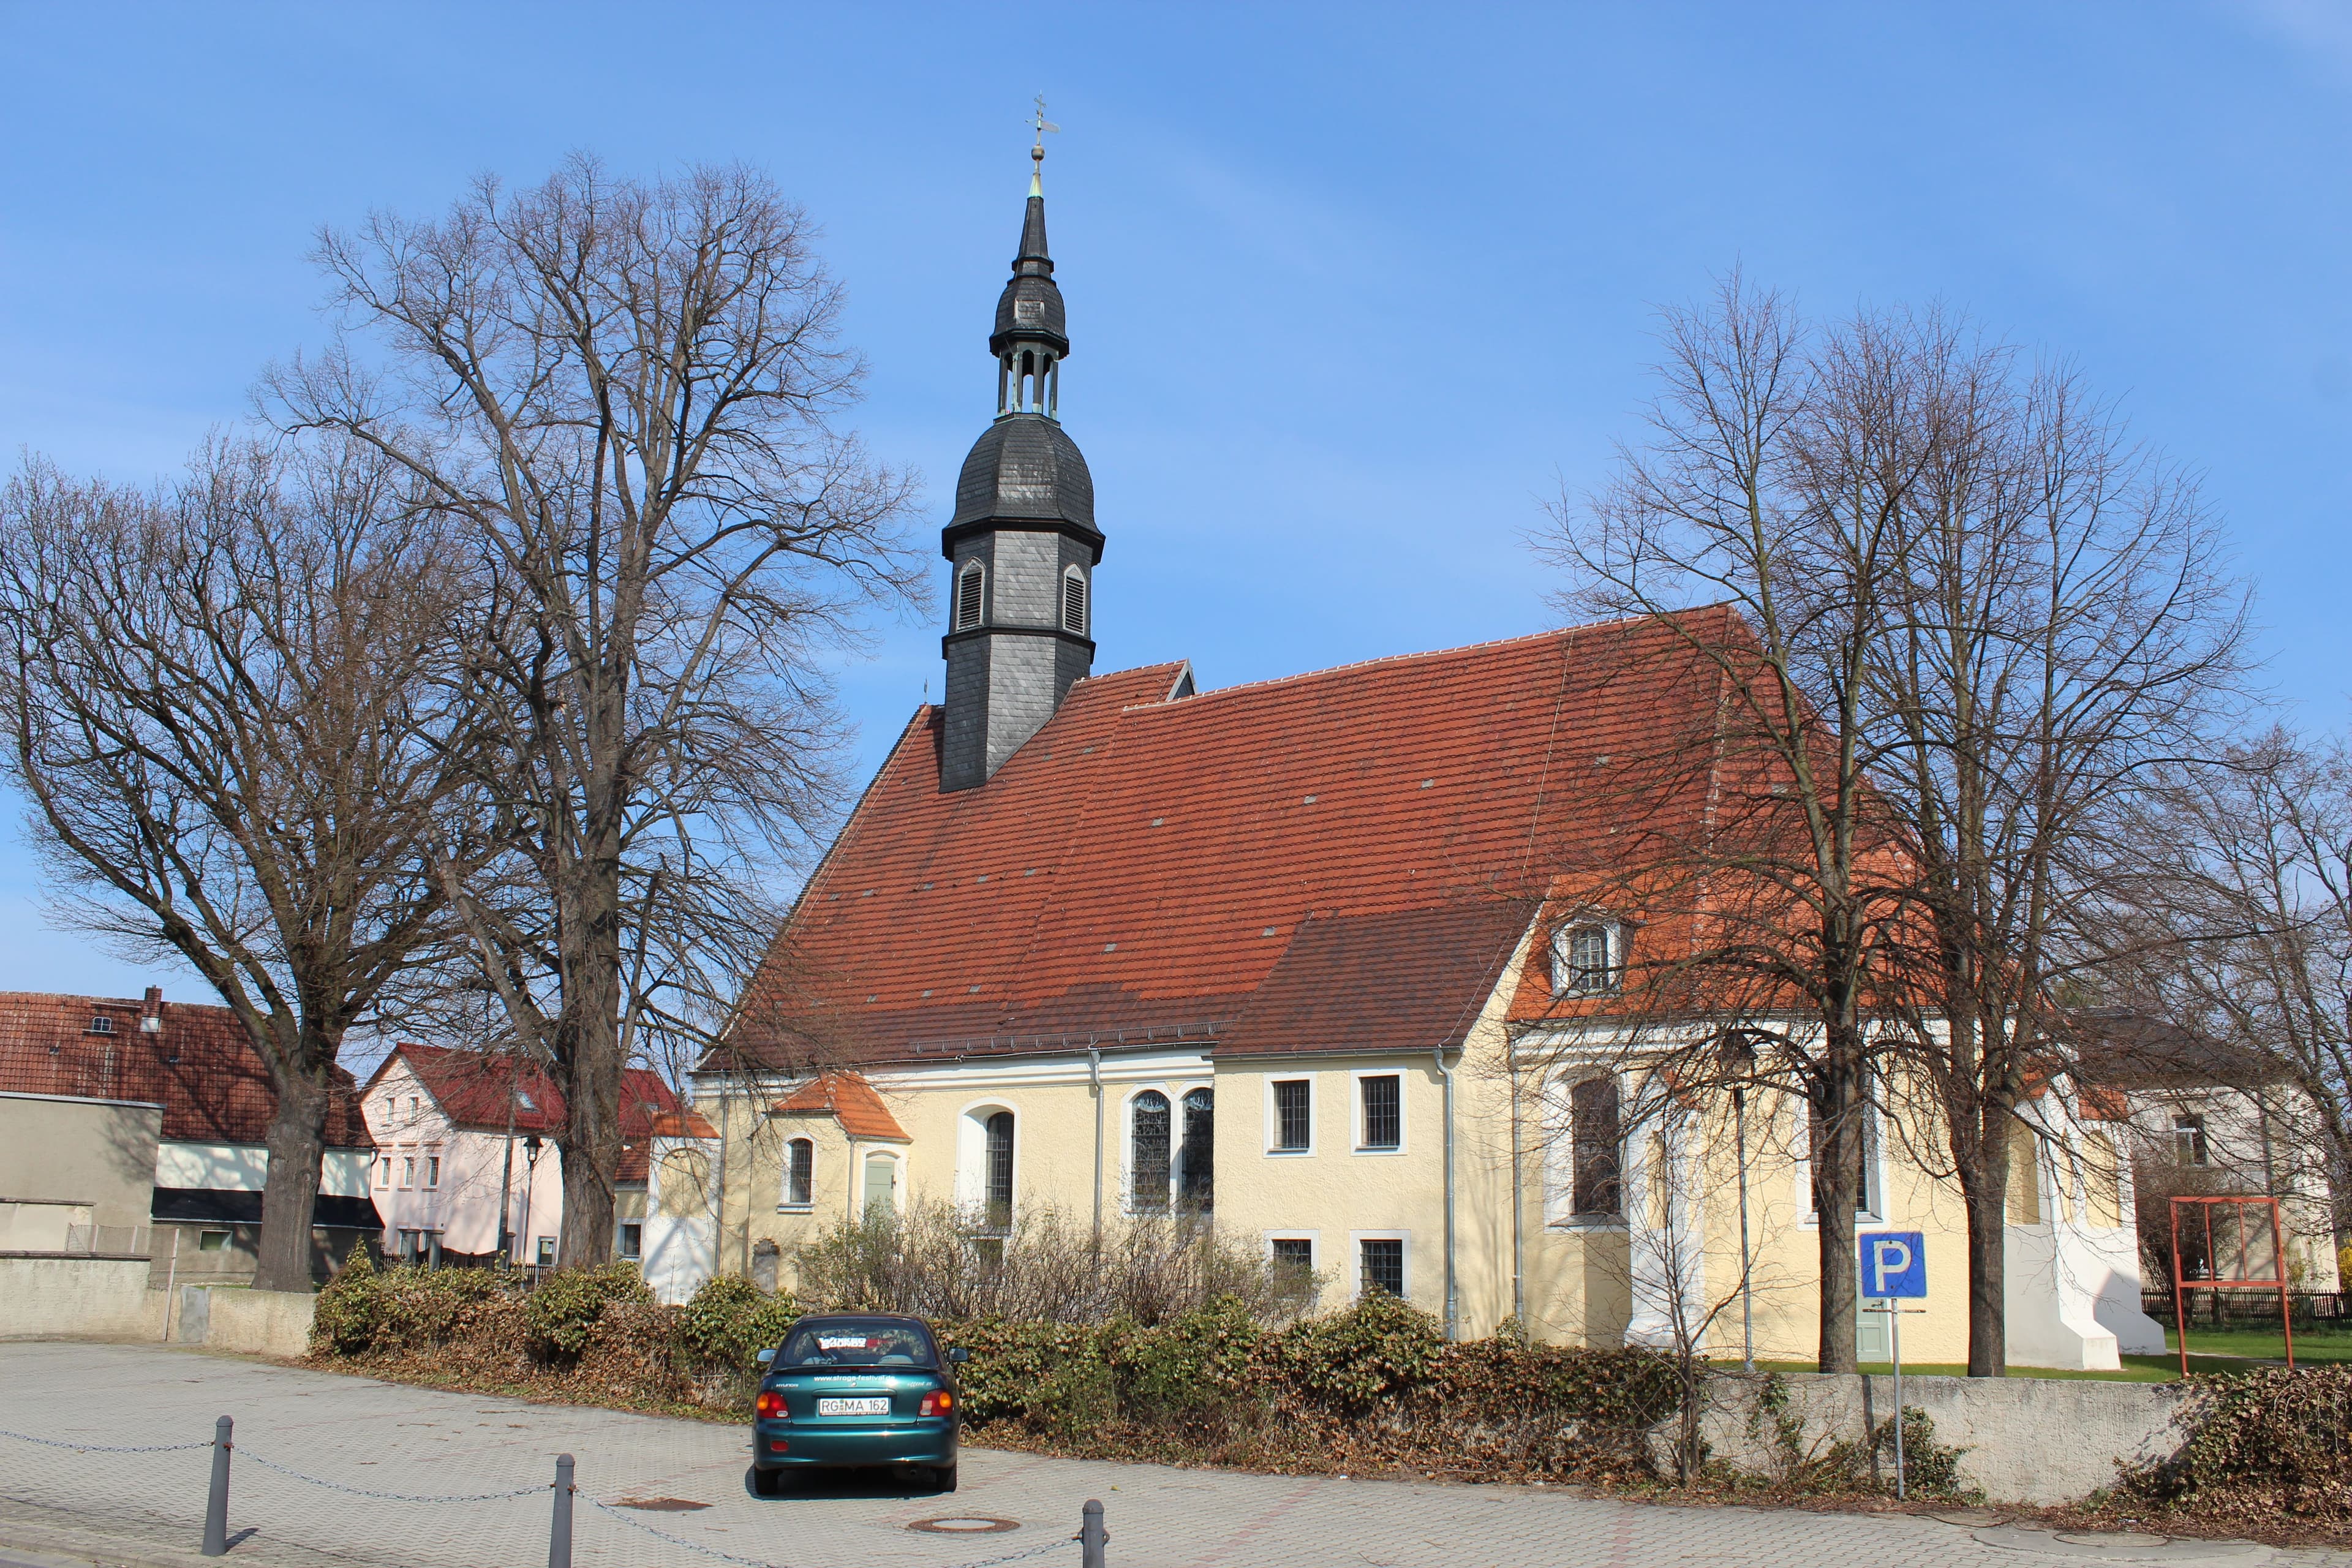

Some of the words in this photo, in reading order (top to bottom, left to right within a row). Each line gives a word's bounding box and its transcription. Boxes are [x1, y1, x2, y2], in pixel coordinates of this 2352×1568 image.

[1874, 1240, 1912, 1292] P
[822, 1400, 839, 1412] RG
[845, 1400, 864, 1411] MA
[869, 1399, 887, 1411] 162
